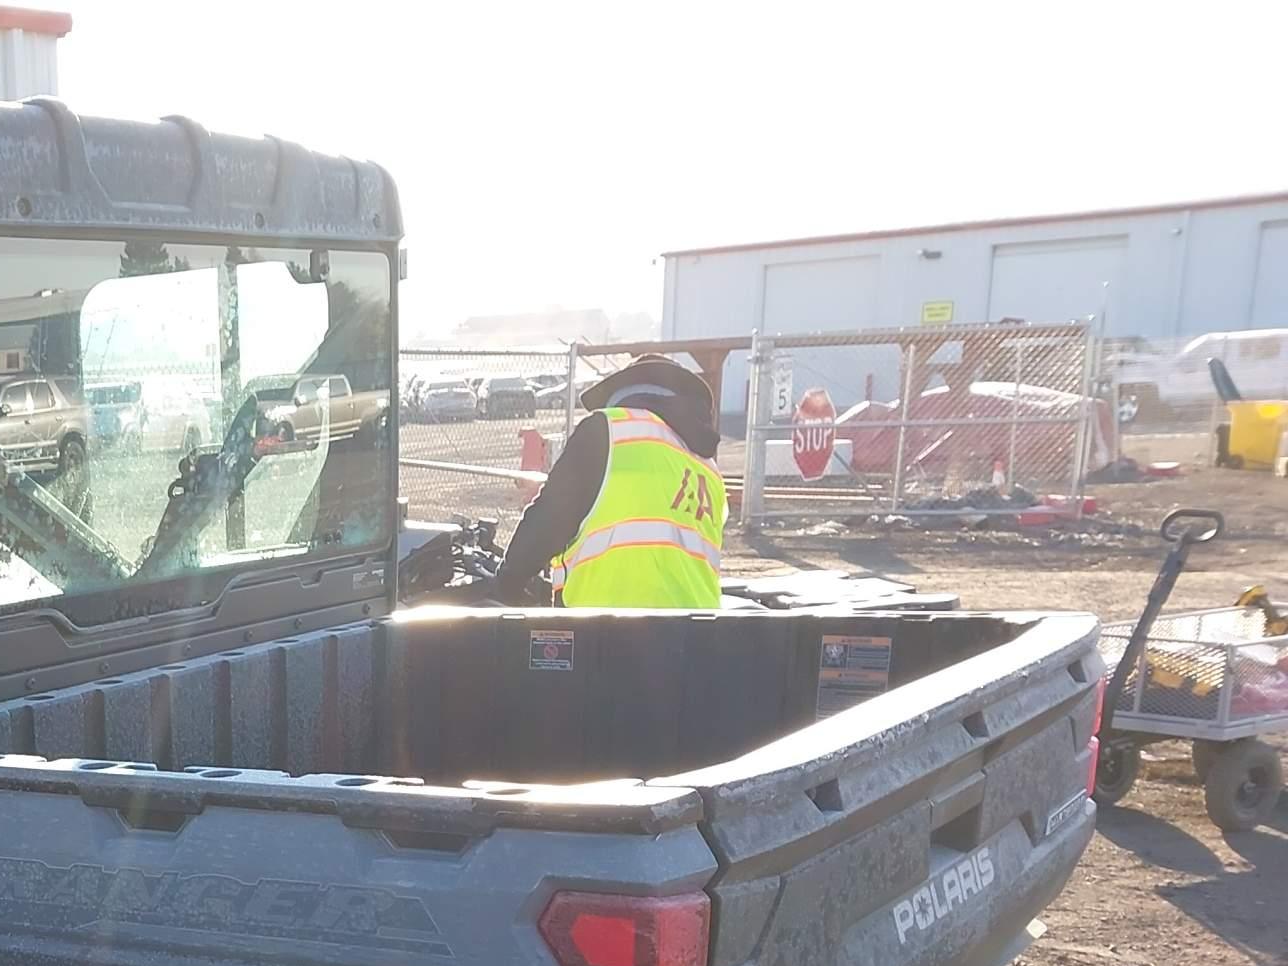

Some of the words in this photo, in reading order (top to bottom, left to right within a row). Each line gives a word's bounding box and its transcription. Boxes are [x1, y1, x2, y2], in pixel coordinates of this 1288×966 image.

[778, 388, 787, 410] 5
[795, 418, 832, 454] STOP
[892, 847, 995, 945] POLARIS
